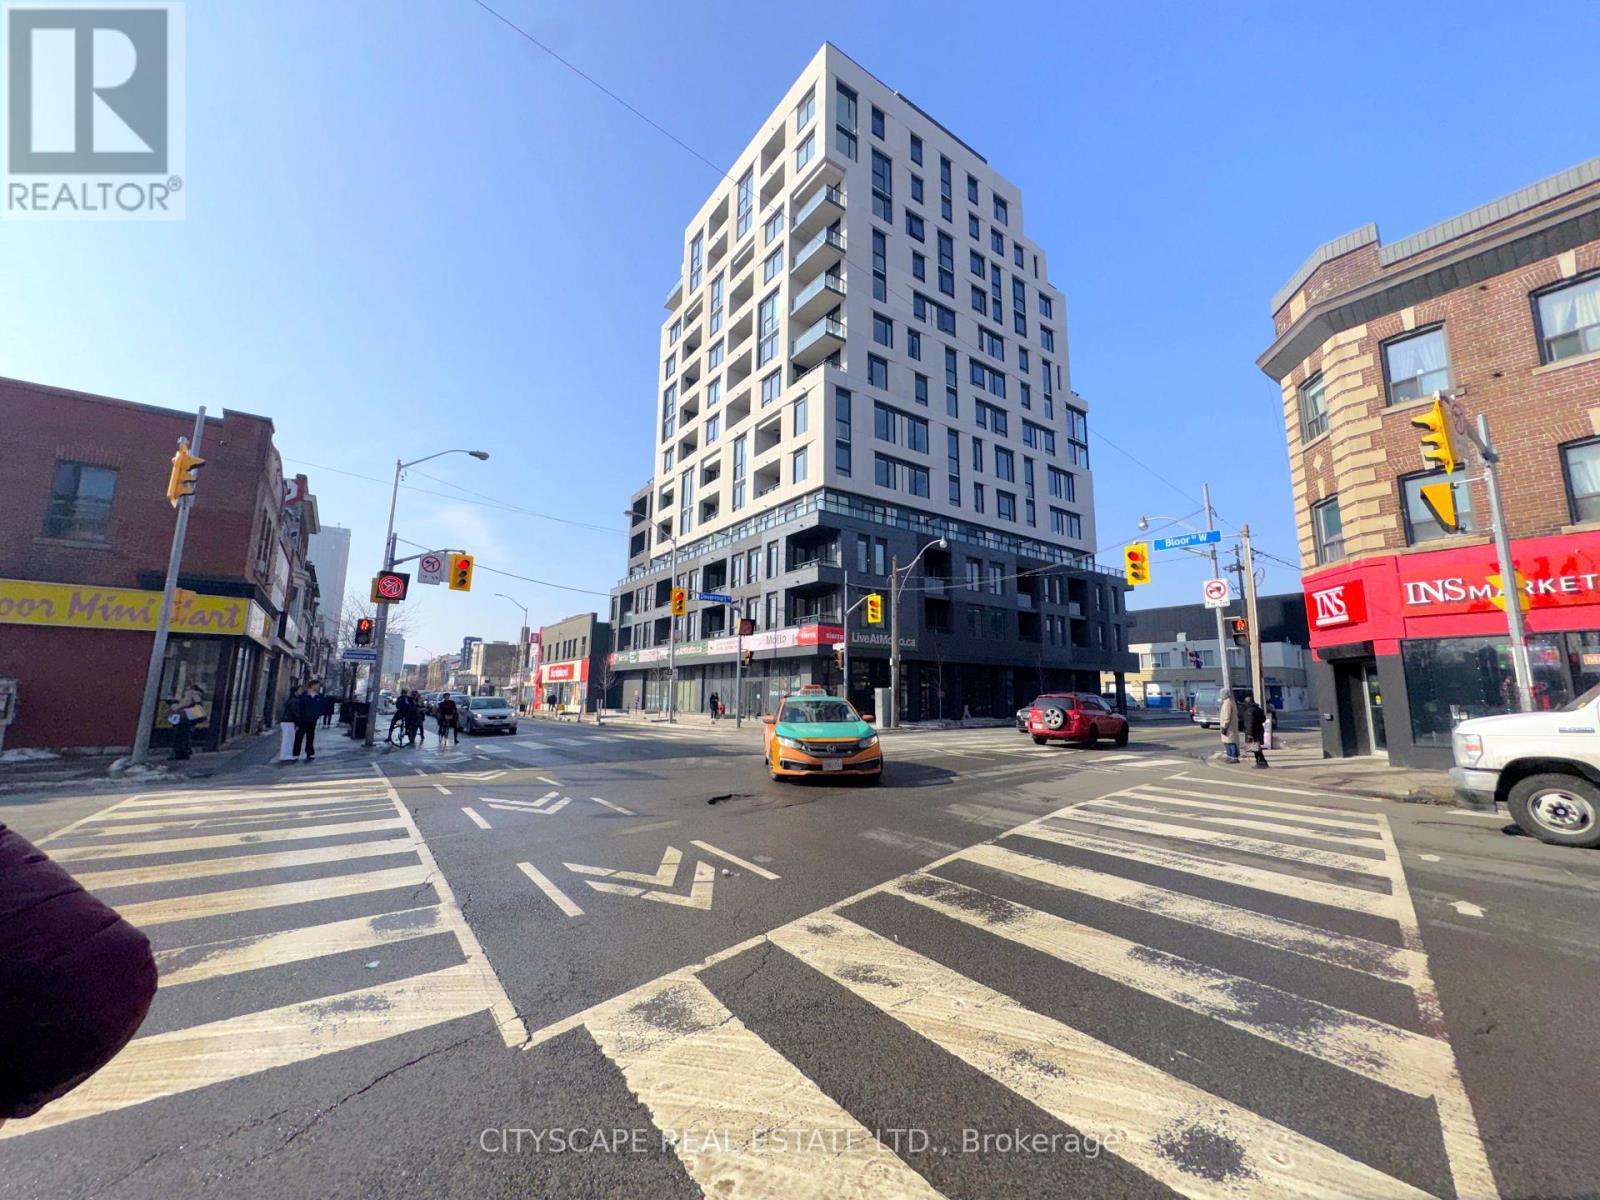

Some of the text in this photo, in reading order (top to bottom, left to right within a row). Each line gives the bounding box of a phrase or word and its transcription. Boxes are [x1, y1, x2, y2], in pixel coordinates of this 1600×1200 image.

[1165, 537, 1190, 547] Bloor
[1198, 533, 1208, 542] W
[1313, 588, 1347, 619] INS
[1404, 577, 1466, 605] INS
[66, 591, 157, 625] Mini
[851, 631, 916, 648] LiveAtMoo.ca
